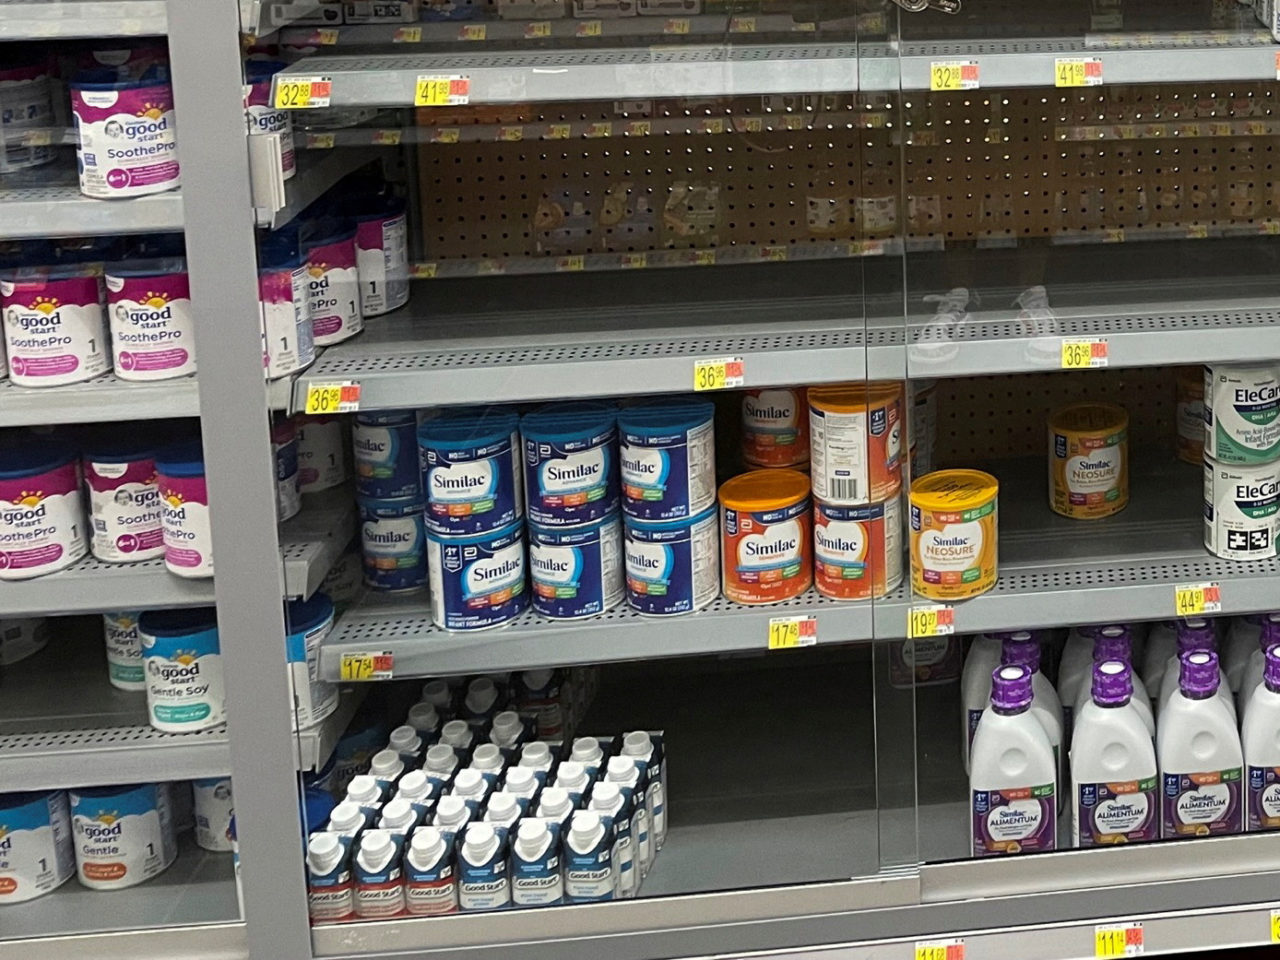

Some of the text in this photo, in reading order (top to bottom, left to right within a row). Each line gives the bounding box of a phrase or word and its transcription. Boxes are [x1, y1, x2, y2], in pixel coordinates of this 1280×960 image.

[125, 117, 168, 139] good
[137, 132, 164, 142] start
[107, 140, 176, 159] SoothePro
[130, 308, 172, 330] good
[118, 328, 182, 344] SoothePro
[548, 463, 600, 480] Similac
[434, 472, 486, 490] Similac
[746, 538, 796, 556] Similac
[933, 535, 969, 546] Similac
[162, 662, 200, 680] good
[152, 683, 210, 698] Gentle Soy
[1179, 798, 1227, 812] ALIMENTUM
[990, 814, 1039, 827] ALIMENTUM
[464, 882, 485, 892] Good
